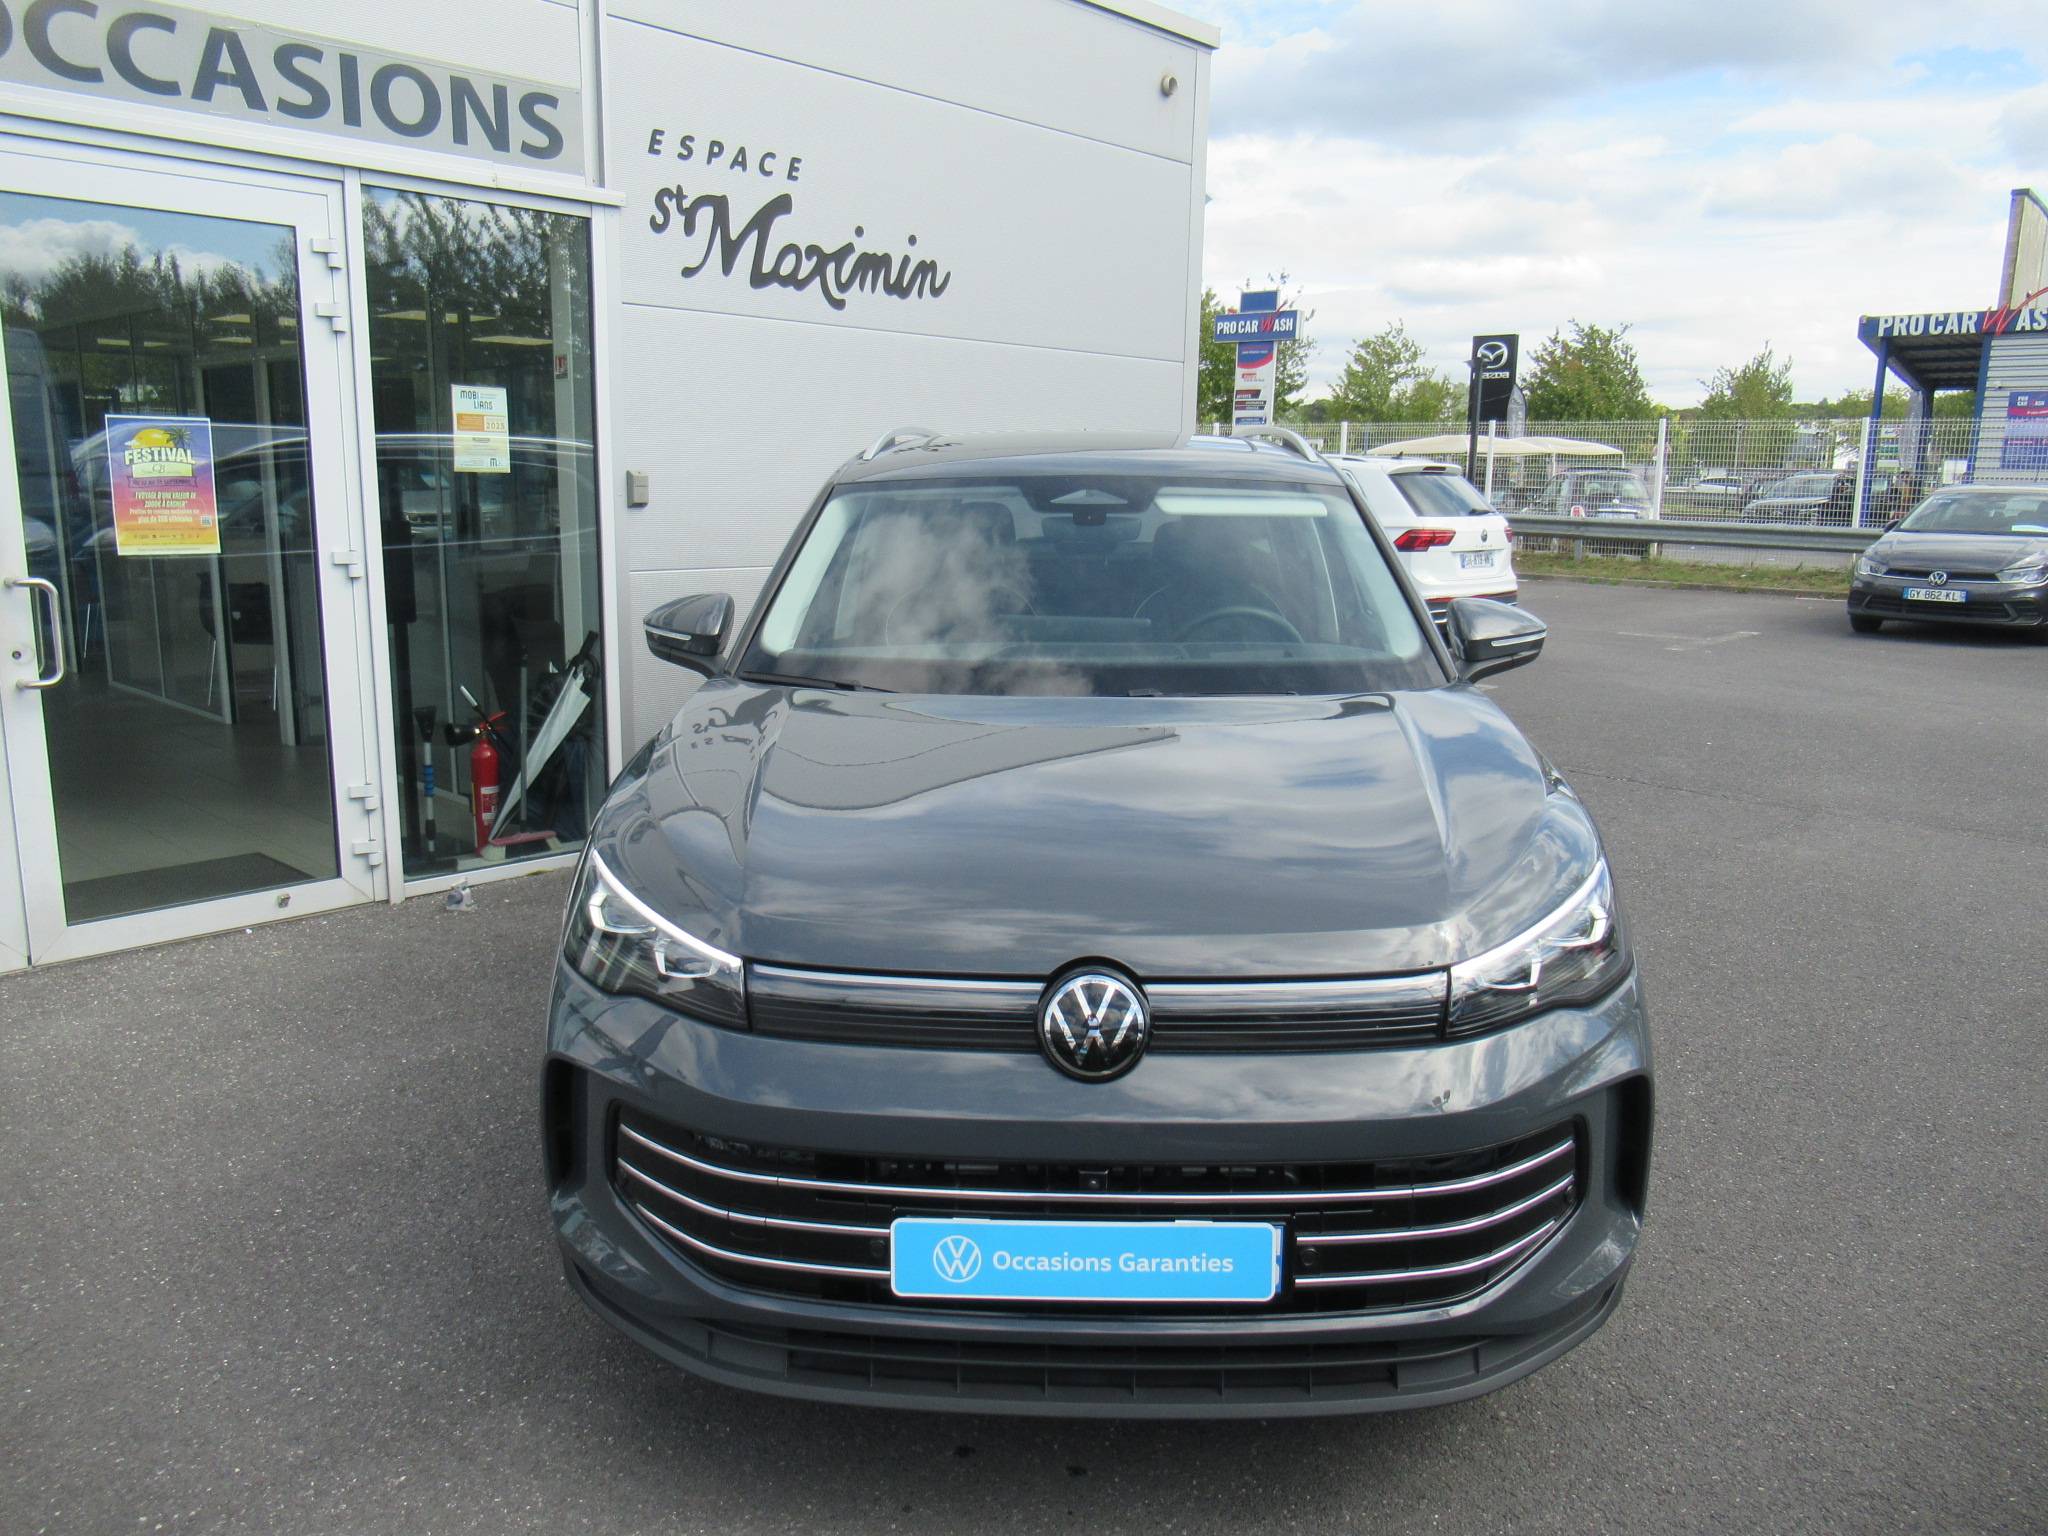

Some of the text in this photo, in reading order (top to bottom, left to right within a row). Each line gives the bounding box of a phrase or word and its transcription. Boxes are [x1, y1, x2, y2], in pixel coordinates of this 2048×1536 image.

[0, 0, 564, 160] CCASIONS
[647, 128, 802, 182] ESPACE
[681, 193, 951, 311] Maximin
[1216, 321, 1237, 335] PRO
[1239, 319, 1259, 334] CAR
[1877, 297, 2048, 338] PRO CAR WAS
[124, 447, 196, 465] FESTIVAL
[992, 1251, 1112, 1274] Occasions
[1118, 1252, 1234, 1274] Garanties
